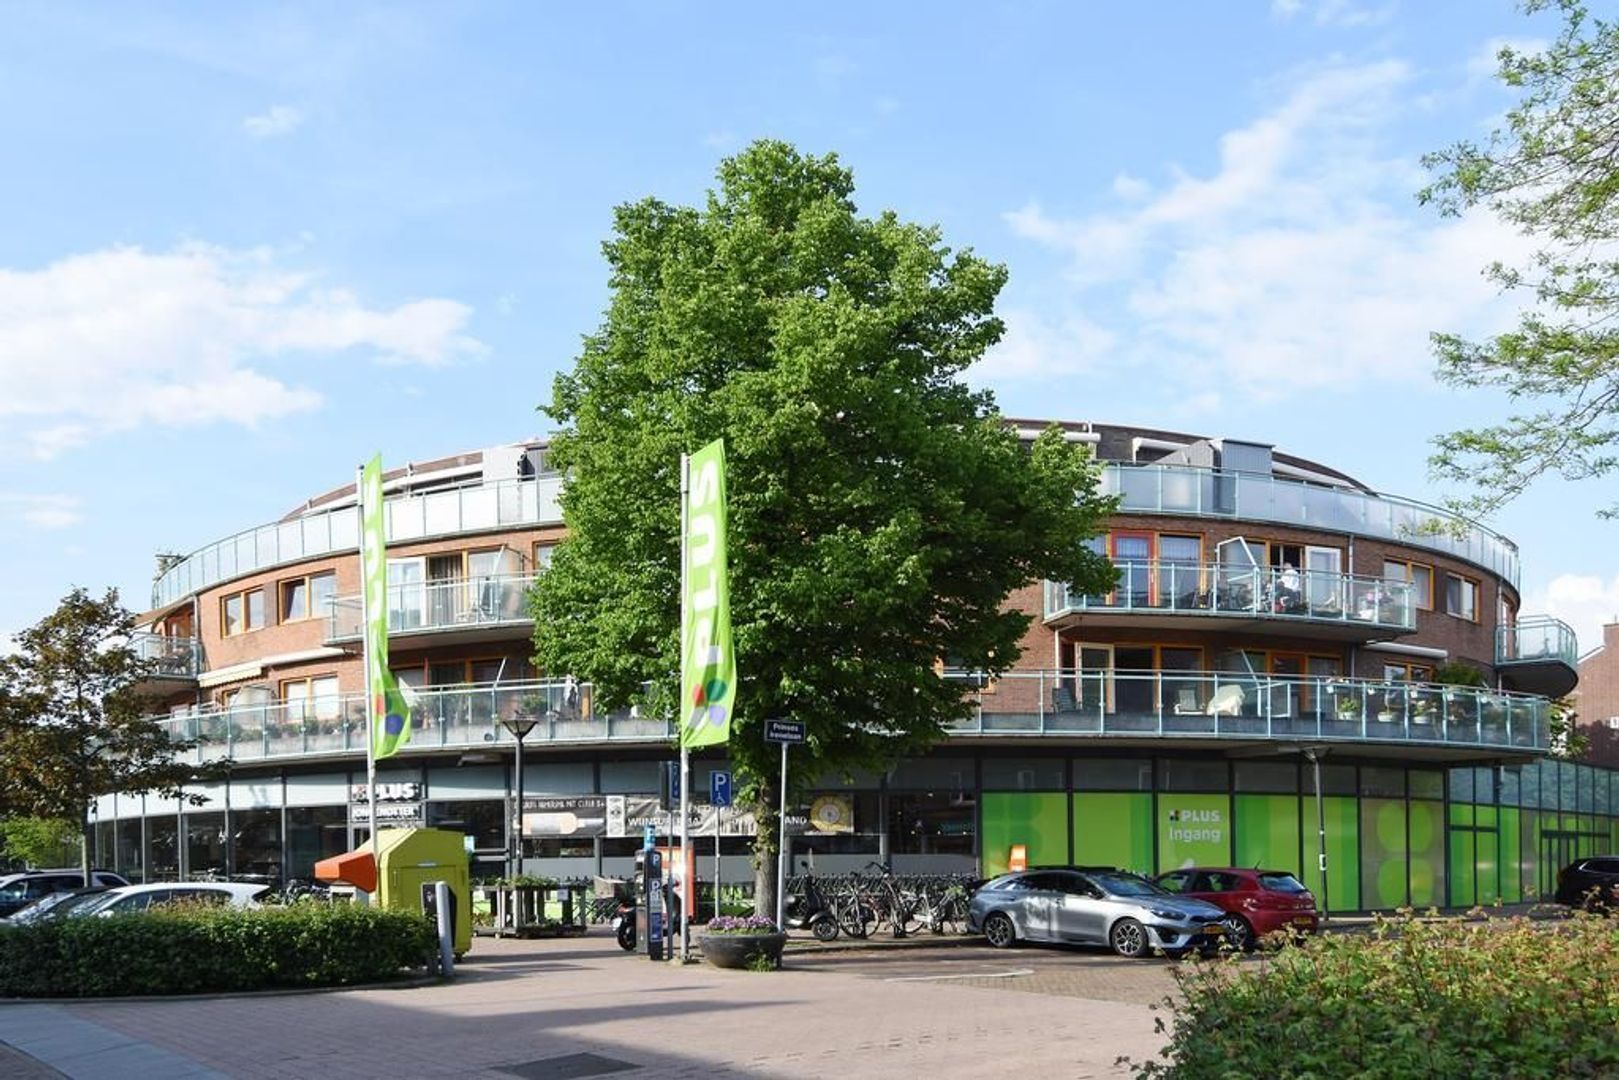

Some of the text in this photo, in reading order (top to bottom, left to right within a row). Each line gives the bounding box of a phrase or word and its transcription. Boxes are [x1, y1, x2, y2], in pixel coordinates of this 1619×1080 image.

[714, 773, 727, 791] P
[1182, 810, 1220, 822] PLUS
[1169, 827, 1221, 843] Ingang
